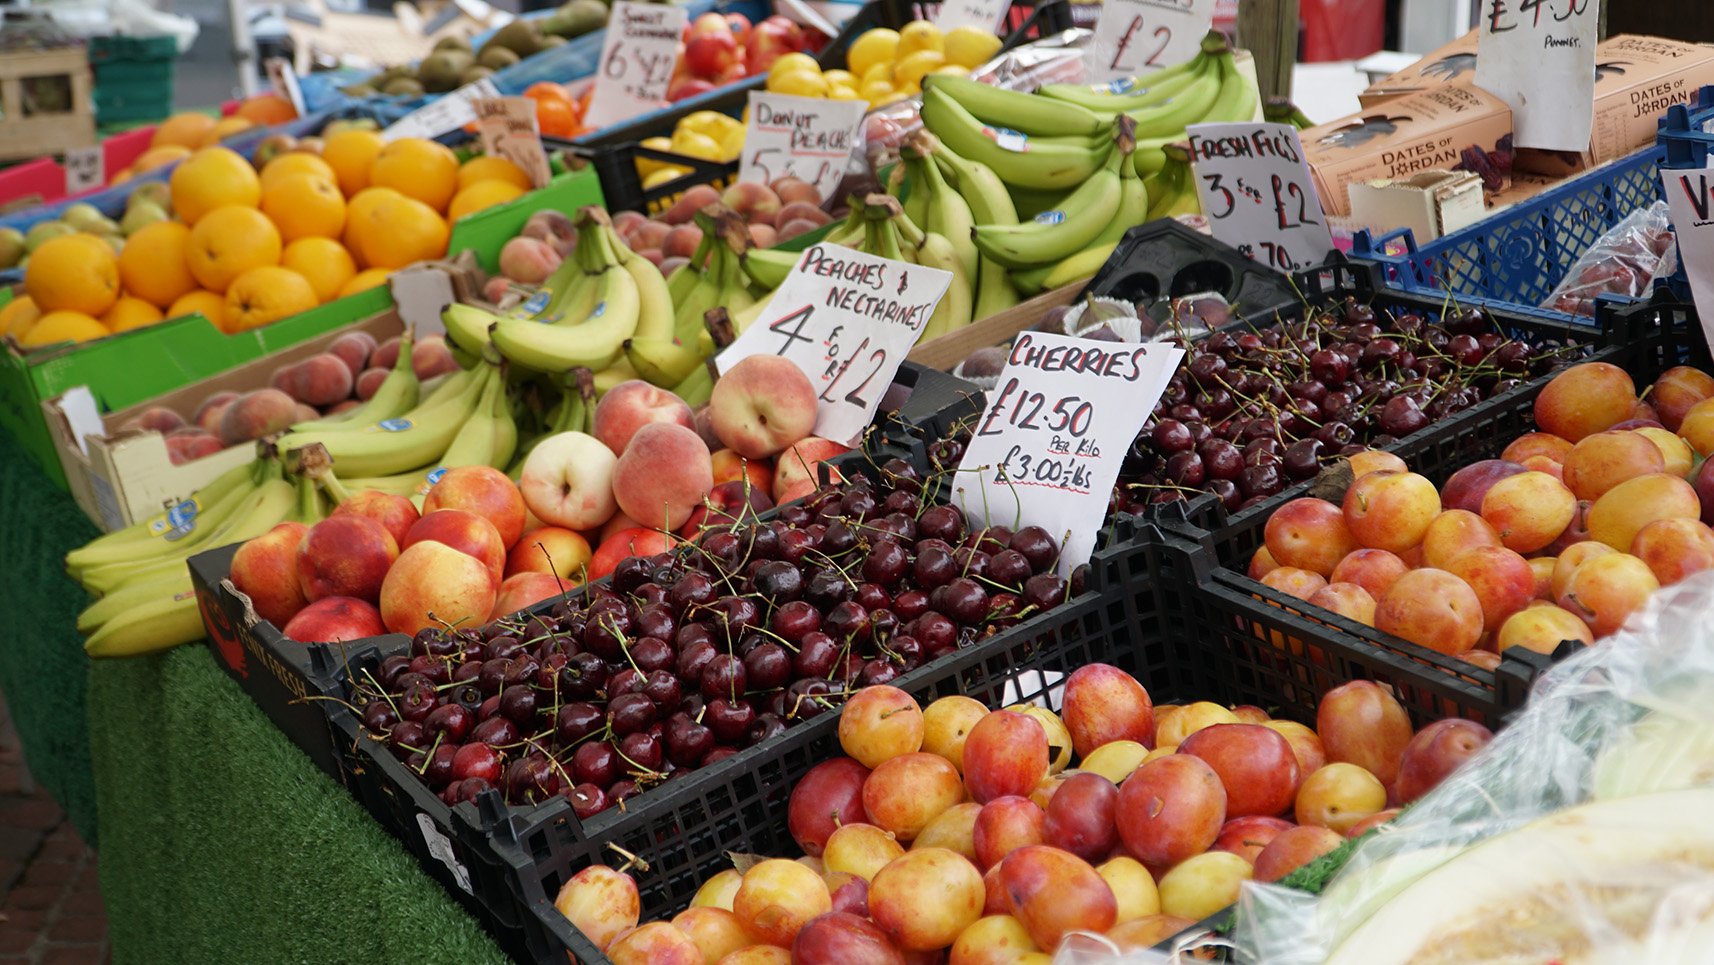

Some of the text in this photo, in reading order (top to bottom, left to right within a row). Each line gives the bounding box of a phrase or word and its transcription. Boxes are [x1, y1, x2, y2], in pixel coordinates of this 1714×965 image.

[604, 40, 628, 79] 6
[1110, 14, 1171, 70] £2
[1630, 78, 1686, 105] DATES OF
[1188, 134, 1253, 163] FRESH
[1381, 136, 1454, 166] DATES OF
[1203, 173, 1236, 220] 3
[1271, 173, 1320, 231] £2
[1680, 174, 1714, 221] V
[800, 245, 887, 291] PEACHES
[824, 285, 932, 332] NECTARINES
[768, 303, 816, 357] 4
[818, 336, 887, 410] £2
[1008, 333, 1148, 382] CHERRIES
[977, 377, 1094, 438] £12.50
